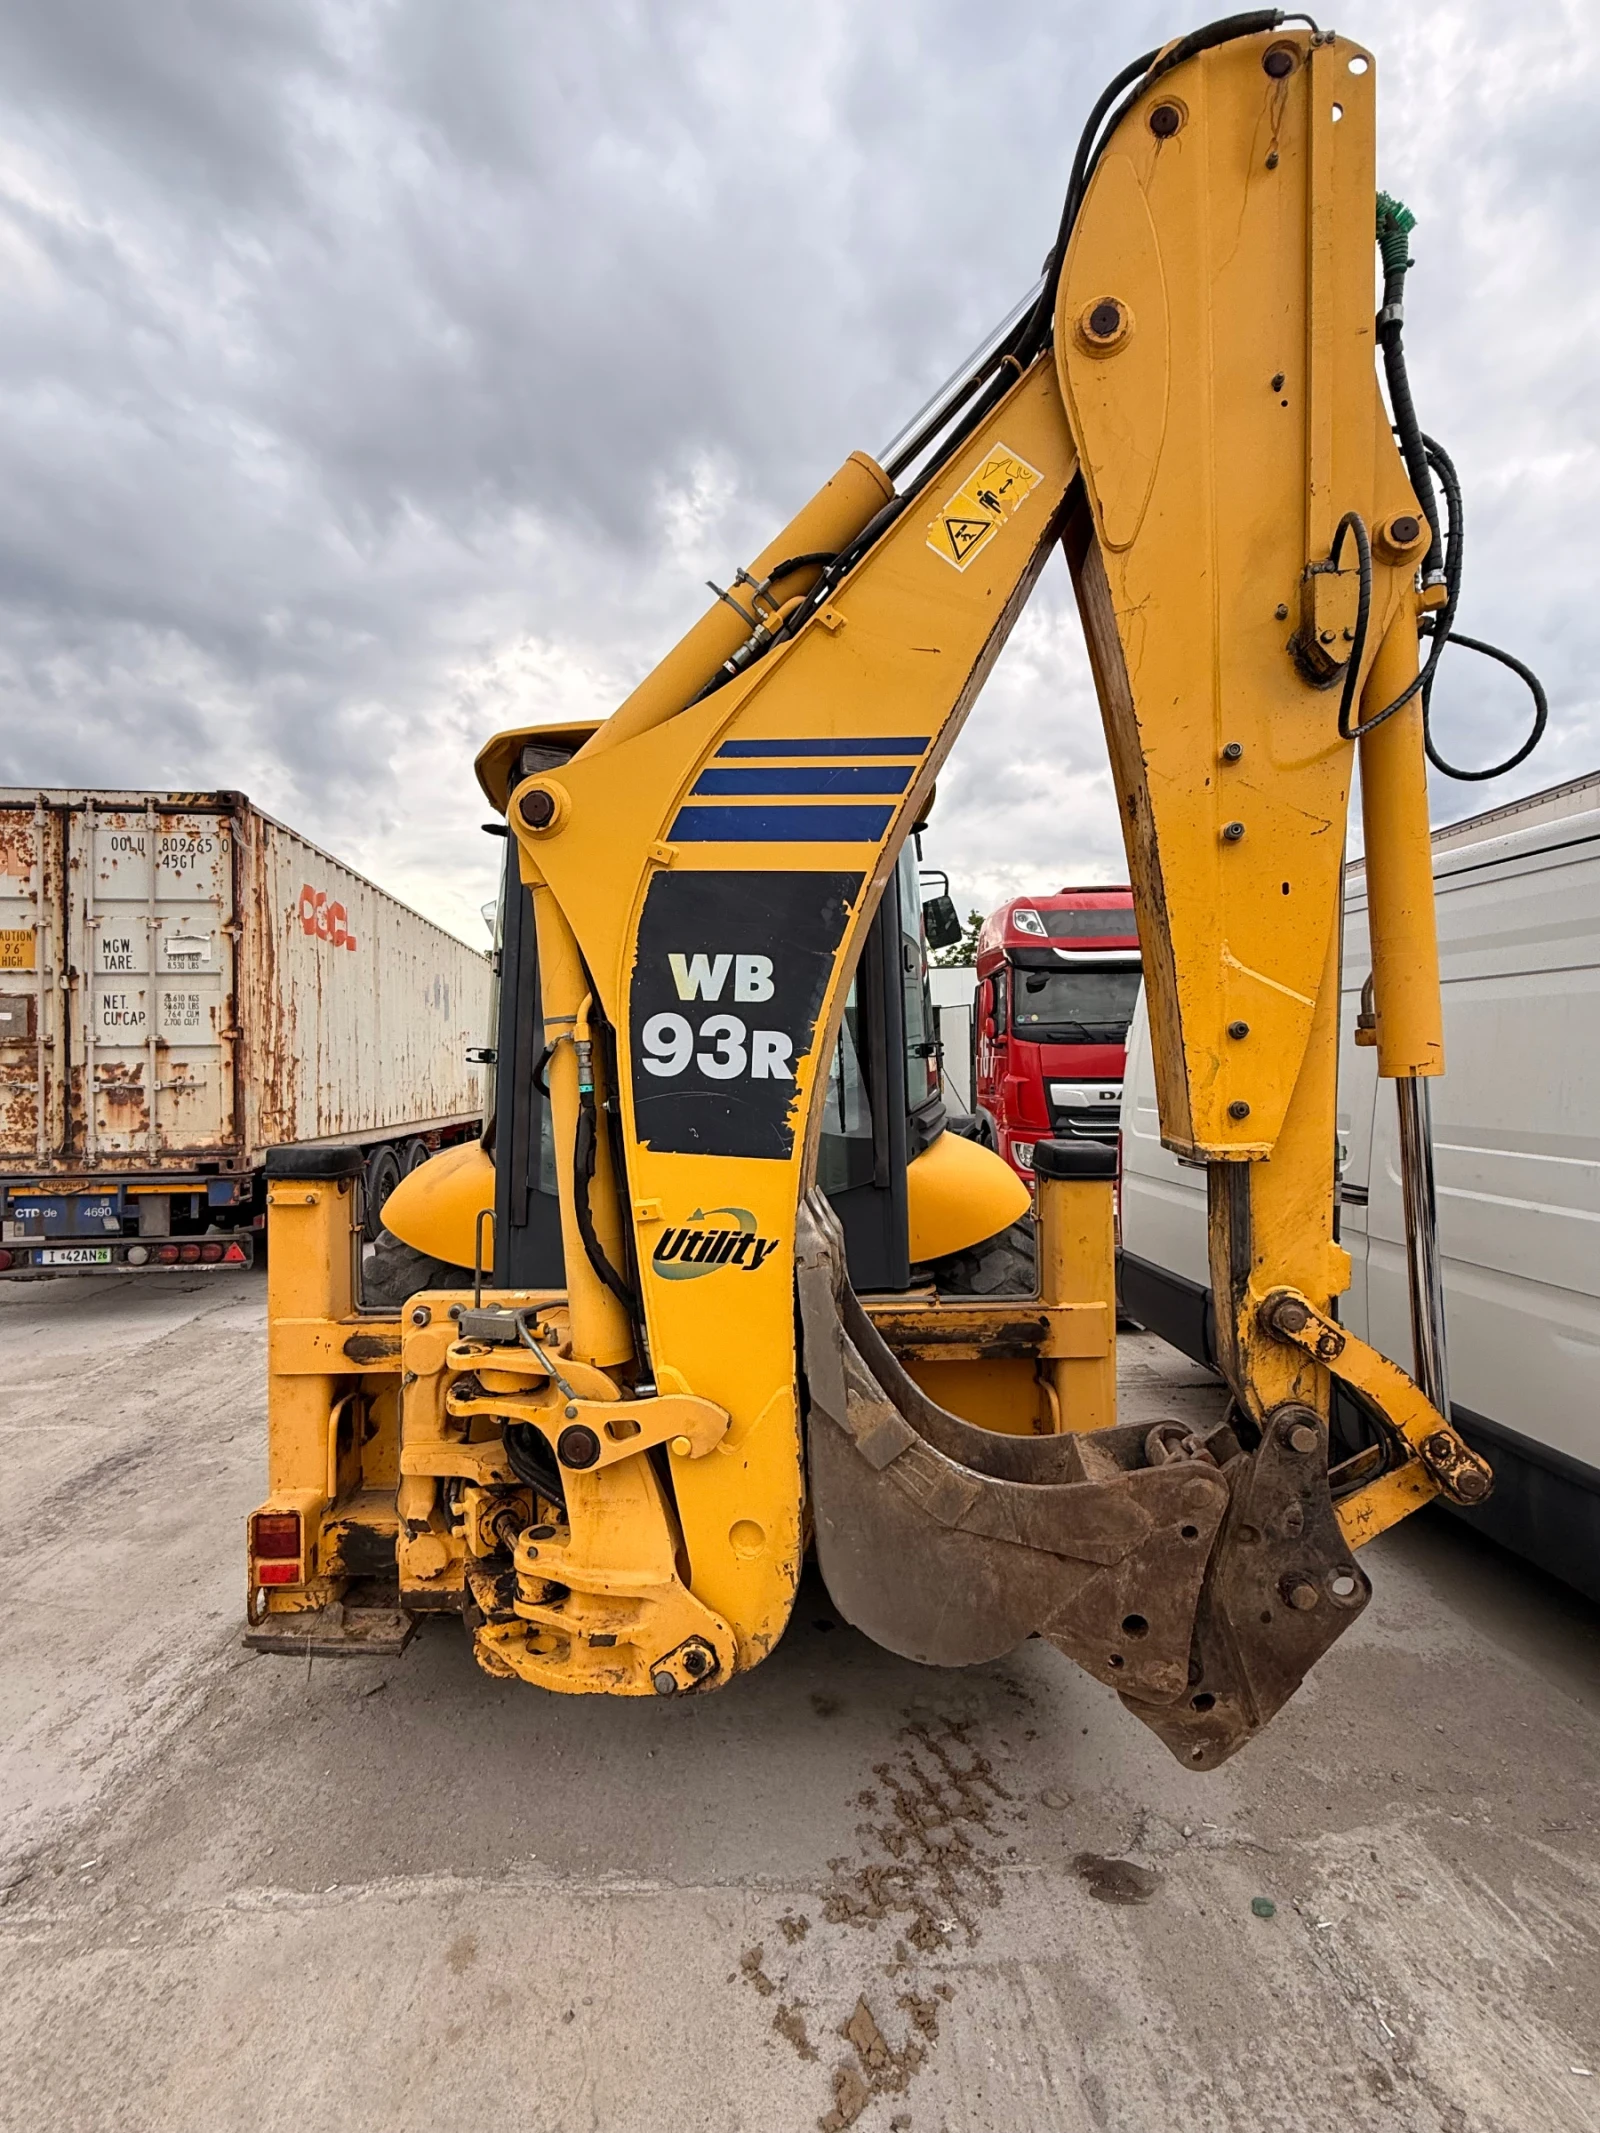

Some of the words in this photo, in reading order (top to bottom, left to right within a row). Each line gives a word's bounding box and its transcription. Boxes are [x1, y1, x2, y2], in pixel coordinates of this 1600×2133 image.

[162, 838, 212, 852] 809665
[2, 956, 23, 967] HIGH
[103, 955, 136, 969] TARE.
[187, 961, 200, 970] LBS
[668, 953, 775, 1002] WB
[188, 994, 200, 1002] KGS
[188, 1002, 200, 1010] LBS
[642, 1012, 794, 1080] 93R
[84, 1207, 112, 1217] 4690
[654, 1227, 780, 1271] Utility
